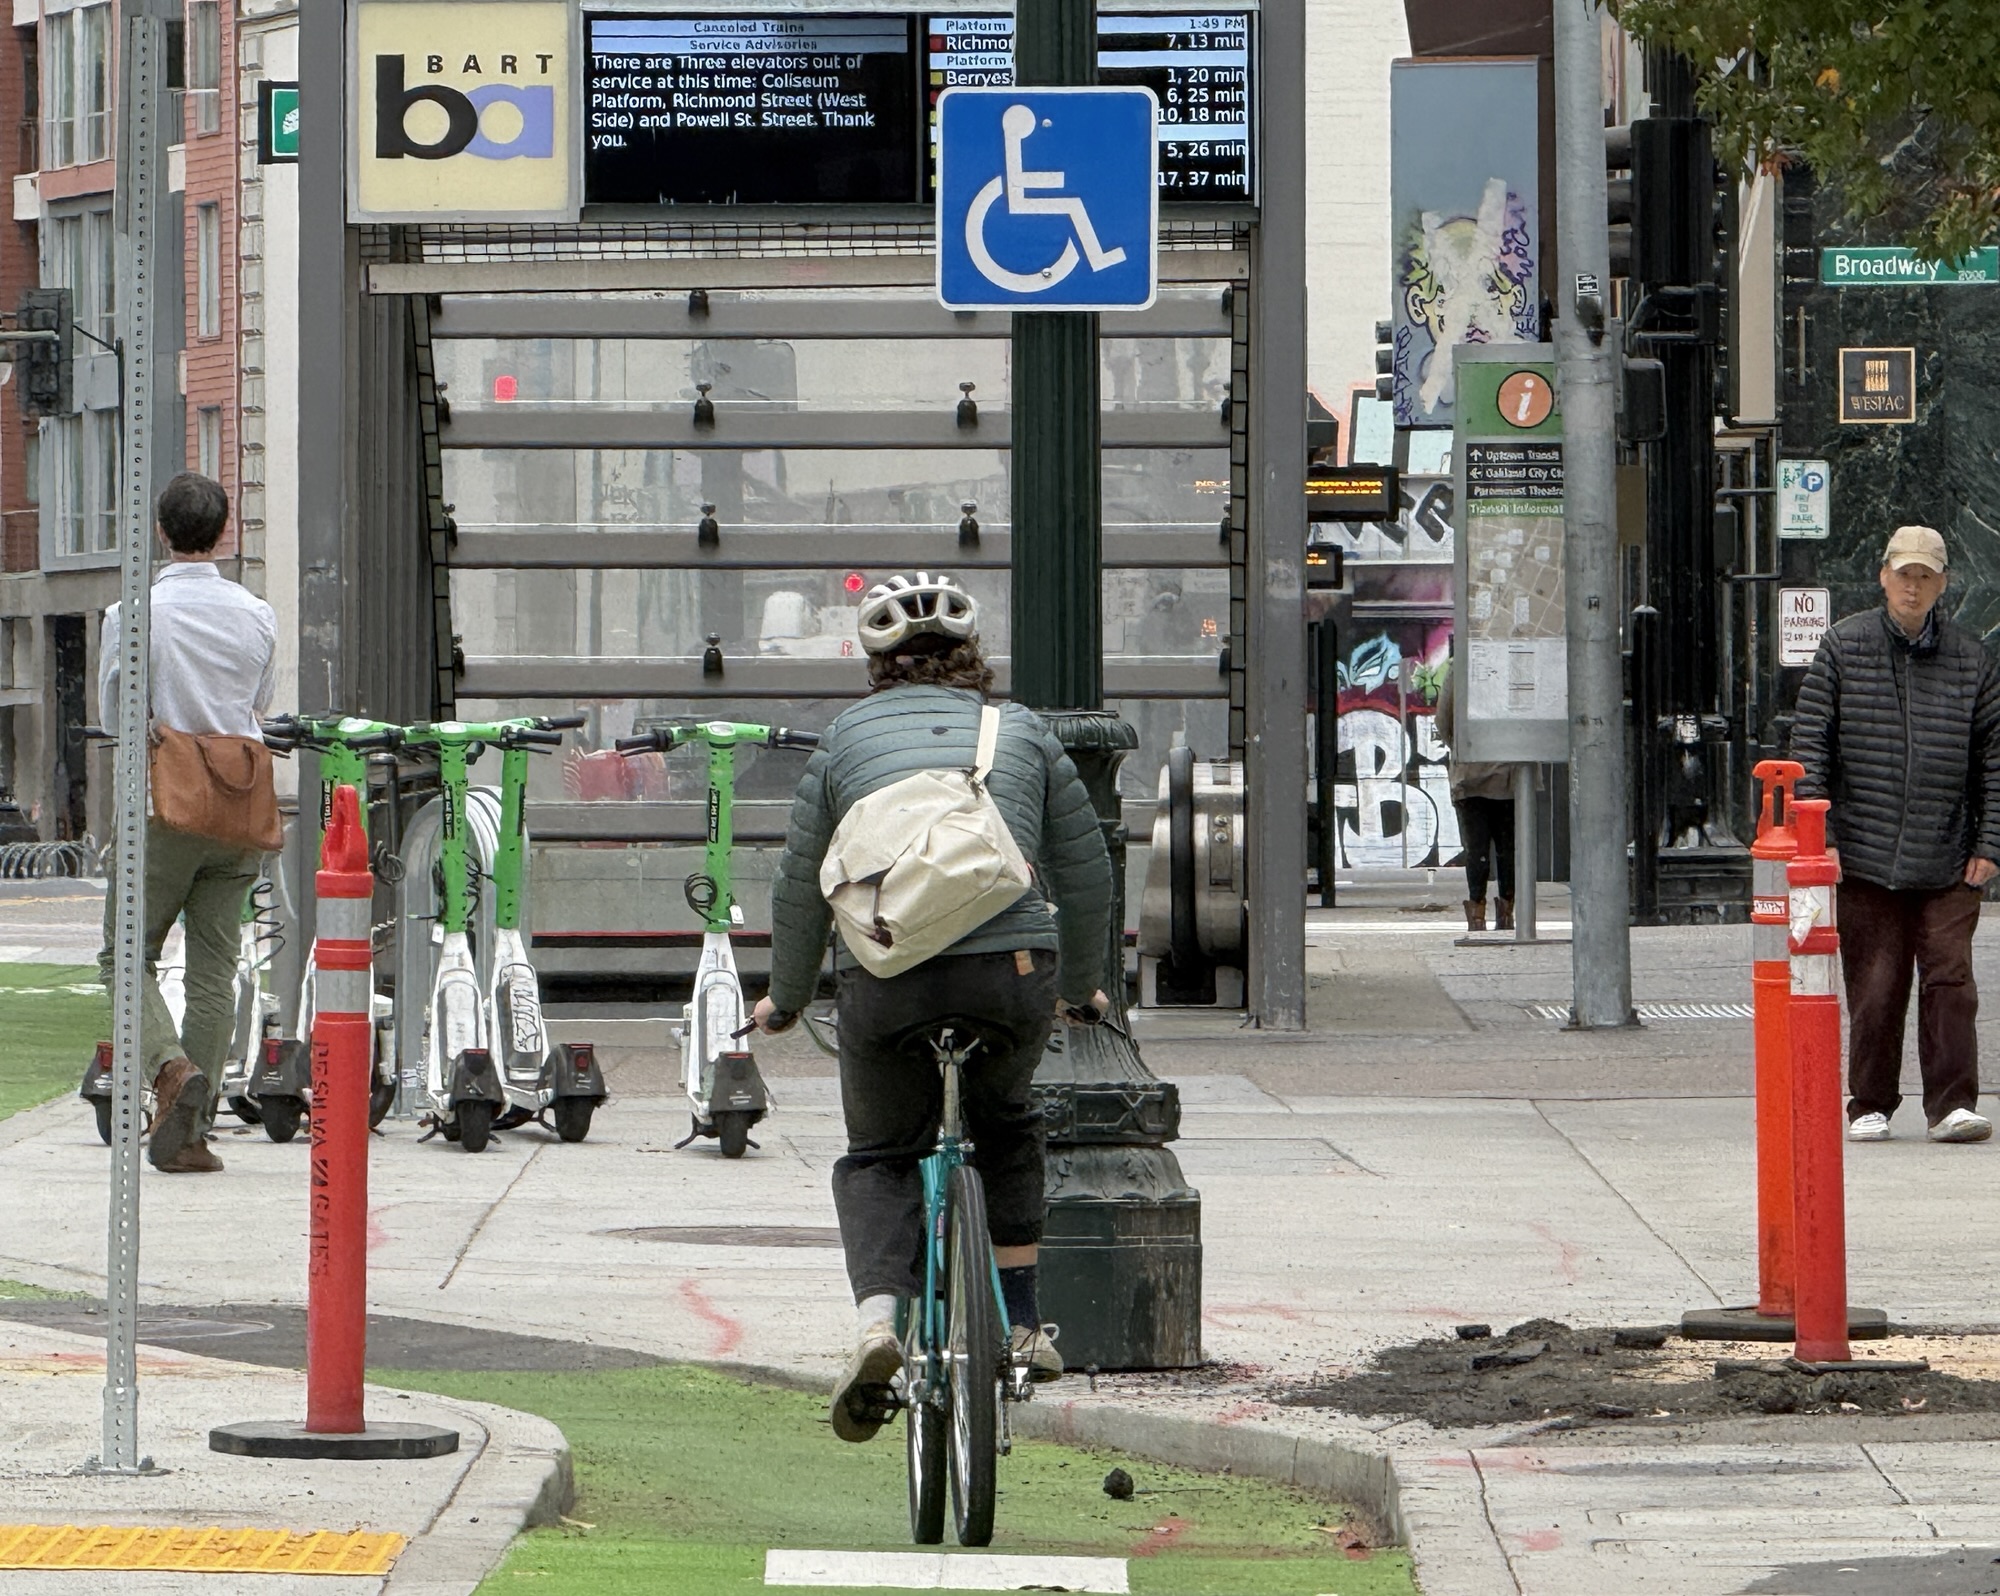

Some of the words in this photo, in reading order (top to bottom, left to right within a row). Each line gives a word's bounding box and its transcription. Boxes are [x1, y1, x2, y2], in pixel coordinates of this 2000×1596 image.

[762, 22, 804, 33] Trains
[946, 20, 1006, 32] Platform
[1189, 18, 1219, 29] 1:49
[1224, 18, 1245, 29] PM
[690, 39, 740, 51] Service
[745, 39, 817, 50] Advisories
[1167, 33, 1182, 50] 7,
[1188, 33, 1208, 48] 13
[1214, 33, 1245, 48] min
[427, 54, 553, 74] BART
[592, 55, 641, 69] There
[645, 58, 672, 69] are
[677, 55, 727, 69] Three
[731, 54, 808, 69] elevators
[813, 55, 841, 69] out
[846, 53, 863, 69] of
[946, 55, 1007, 66] Platform
[592, 73, 652, 89] service
[657, 74, 674, 89] at
[679, 73, 709, 89] this
[714, 73, 757, 88] time:
[762, 73, 840, 88] Coliseum
[1167, 68, 1182, 84] 1,
[1188, 68, 1209, 83] 20
[1214, 68, 1245, 83] min
[592, 93, 667, 109] Platform,
[673, 93, 756, 108] Richmond
[761, 92, 813, 108] Street
[817, 92, 867, 109] (West
[1167, 88, 1182, 104] 6,
[1188, 88, 1209, 103] 25
[1214, 87, 1245, 102] min
[592, 112, 634, 129] Side)
[639, 112, 670, 127] and
[676, 112, 729, 127] Powell
[822, 111, 875, 127] Thank
[1158, 107, 1183, 123] 10,
[1189, 107, 1209, 122] 18
[1215, 107, 1245, 122] min
[592, 134, 627, 149] you.
[1167, 142, 1183, 158] 5,
[1188, 142, 1209, 157] 26
[1215, 141, 1246, 157] min
[1158, 171, 1183, 187] 17,
[1188, 171, 1209, 186] 37
[1215, 170, 1246, 186] min
[1836, 254, 1941, 281] Broadway
[1485, 467, 1526, 478] Oakland
[1794, 596, 1814, 613] NO
